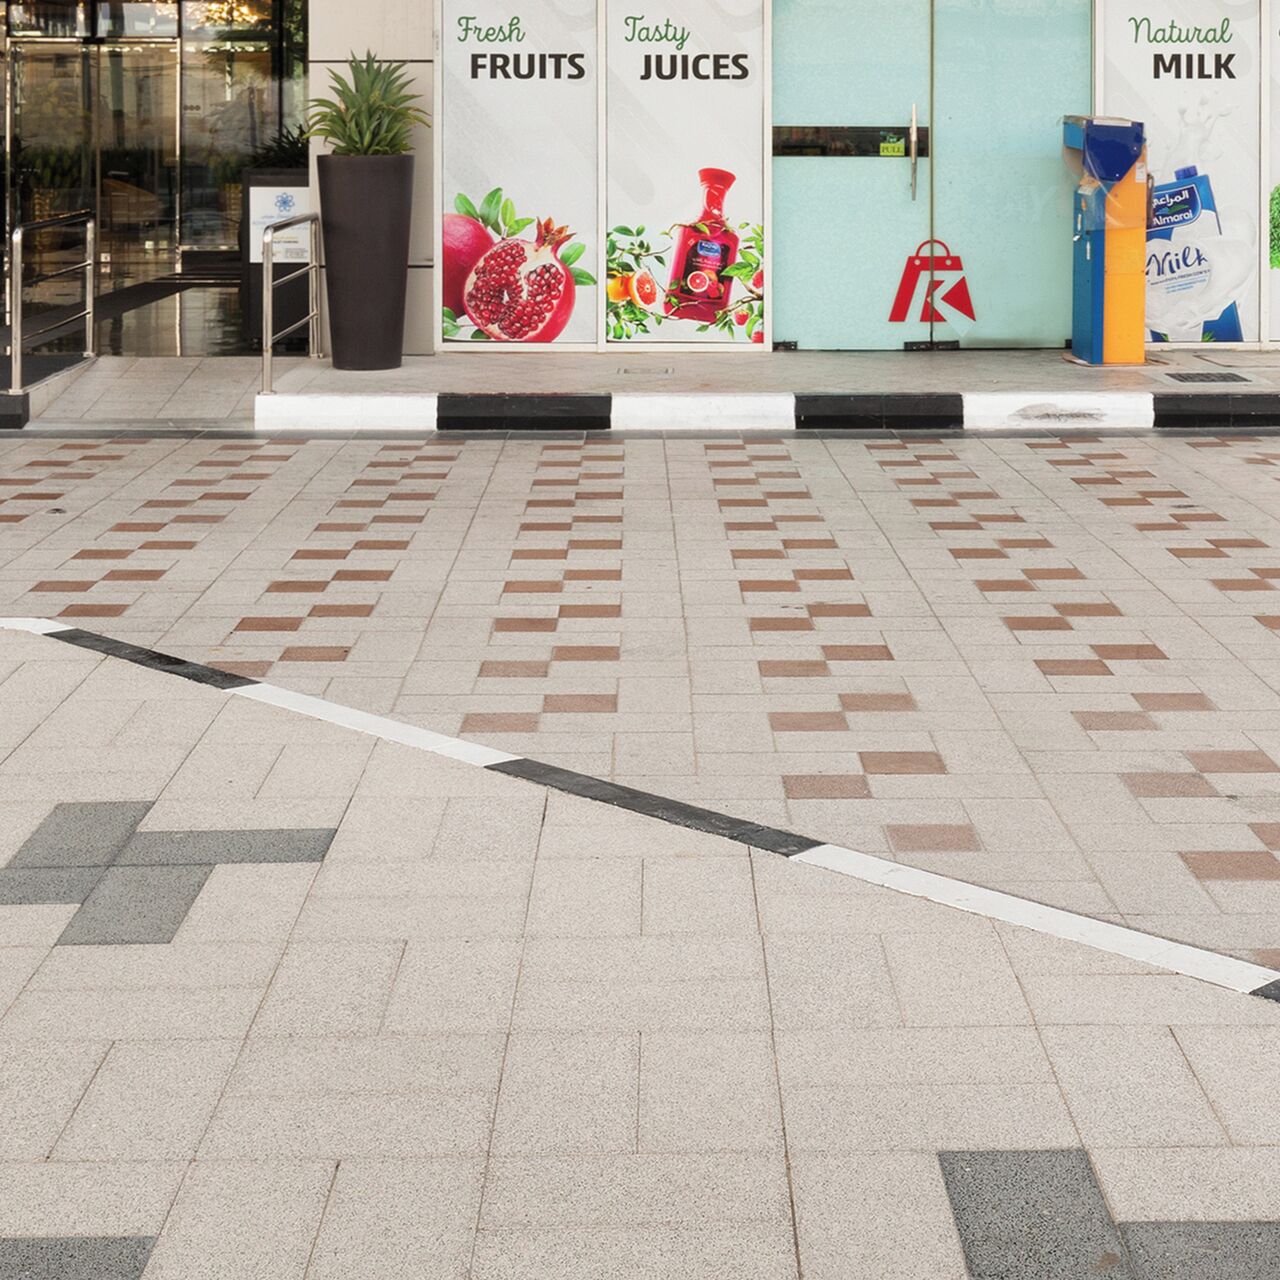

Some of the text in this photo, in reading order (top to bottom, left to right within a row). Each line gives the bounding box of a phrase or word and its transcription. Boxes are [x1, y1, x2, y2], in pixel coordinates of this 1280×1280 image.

[456, 16, 526, 45] Fresh
[624, 15, 691, 51] Tasty
[1128, 16, 1234, 45] Natural
[470, 53, 585, 80] FRUITS
[640, 53, 749, 80] JUICES
[1153, 53, 1236, 79] MILK
[1145, 246, 1208, 277] Milk
